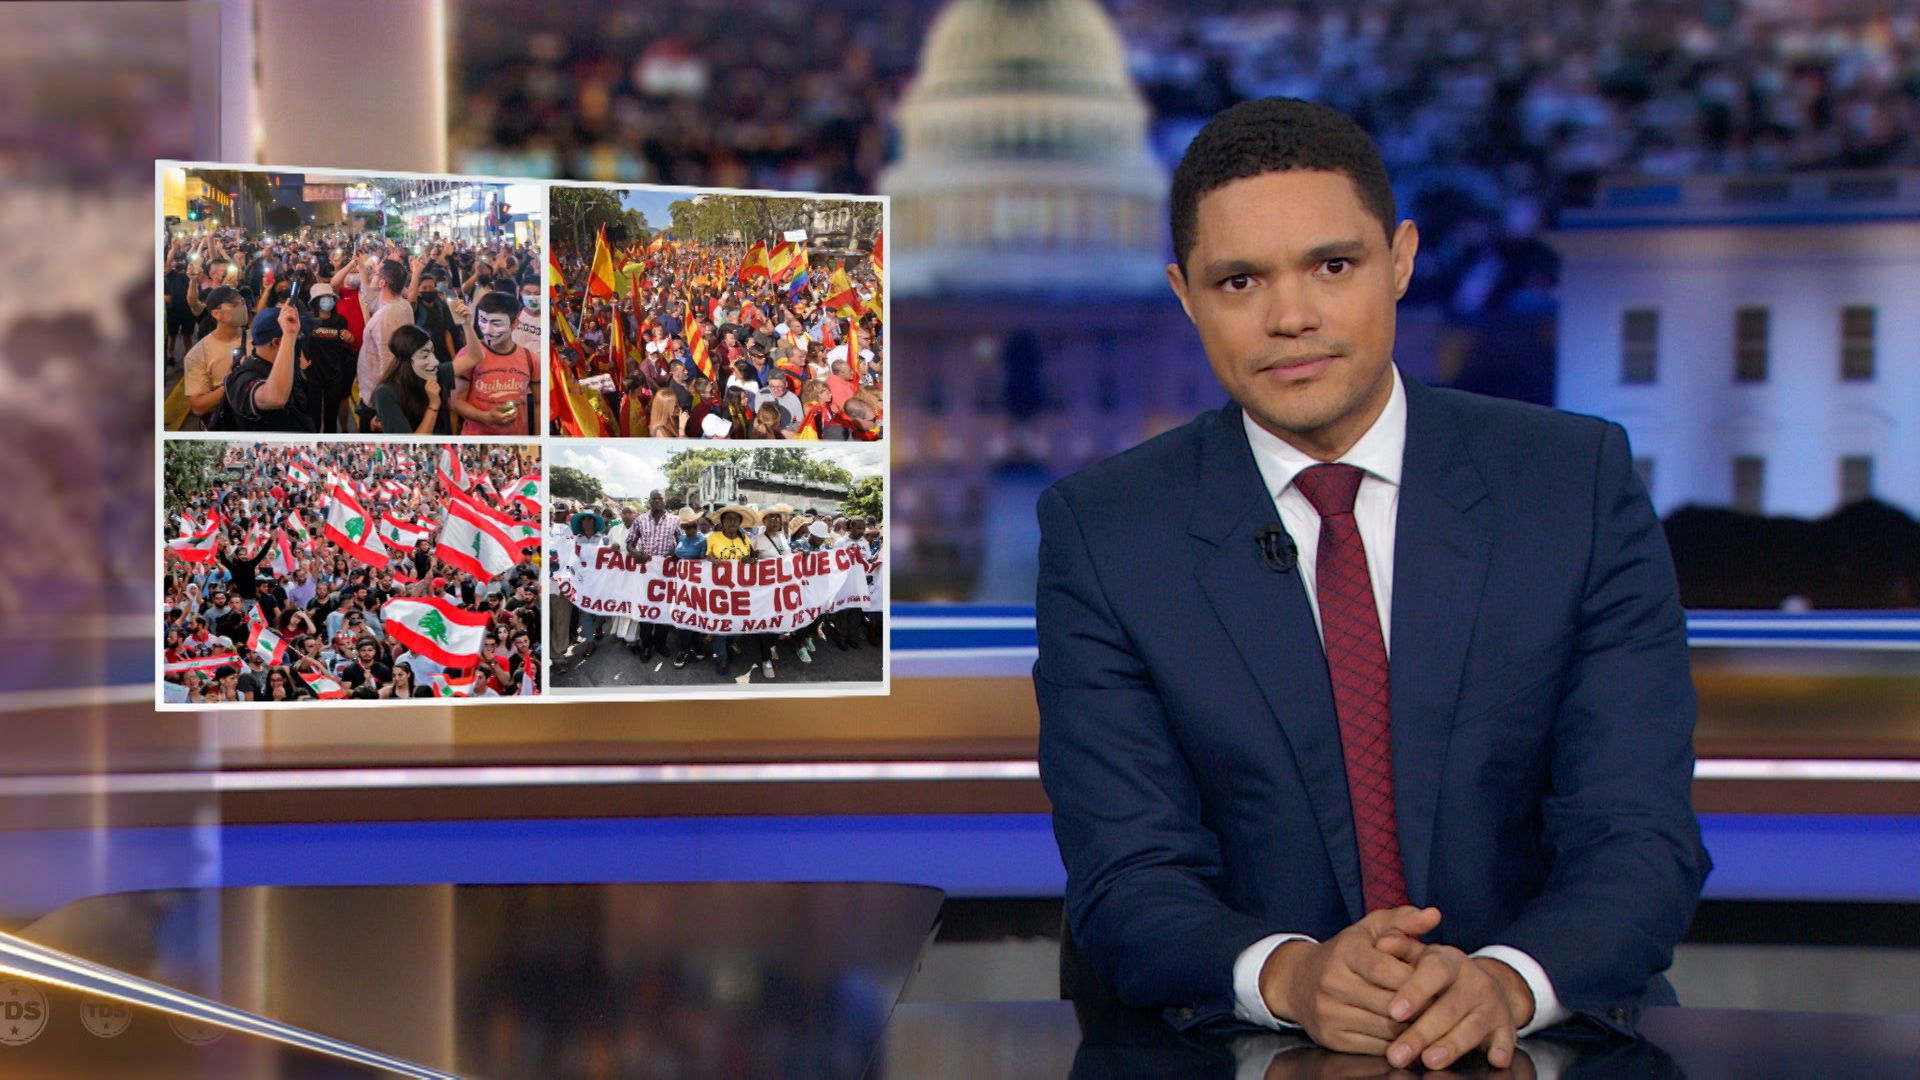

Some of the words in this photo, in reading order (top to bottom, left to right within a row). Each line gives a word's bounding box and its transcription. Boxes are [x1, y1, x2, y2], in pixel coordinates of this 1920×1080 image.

[662, 556, 702, 584] QUE
[711, 551, 831, 589] QUELQUE
[647, 579, 751, 616] CHANGE
[637, 604, 661, 620] YO
[742, 615, 784, 632] NAN
[87, 1003, 127, 1019] TDS
